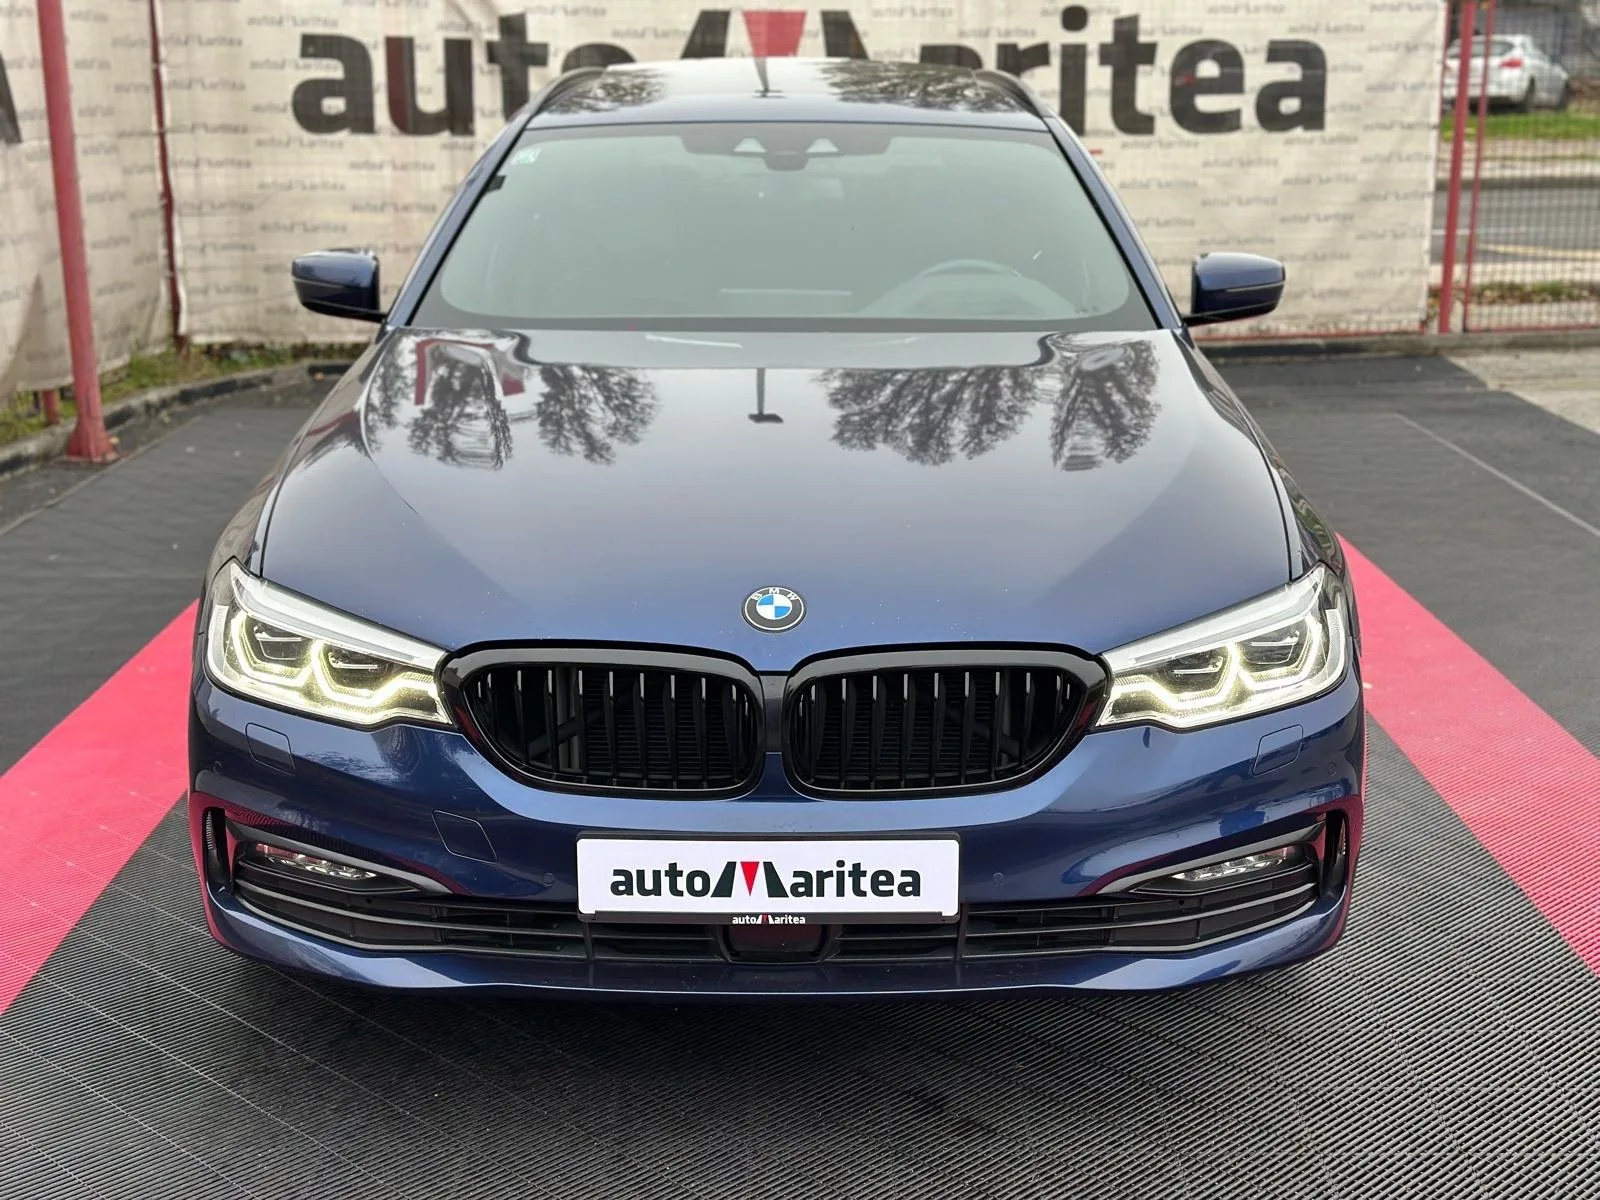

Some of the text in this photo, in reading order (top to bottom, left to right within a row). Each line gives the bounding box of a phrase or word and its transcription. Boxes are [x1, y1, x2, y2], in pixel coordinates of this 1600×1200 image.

[750, 587, 801, 601] BMW
[610, 859, 922, 899] autoMaritea
[732, 914, 807, 926] autoMaritea
